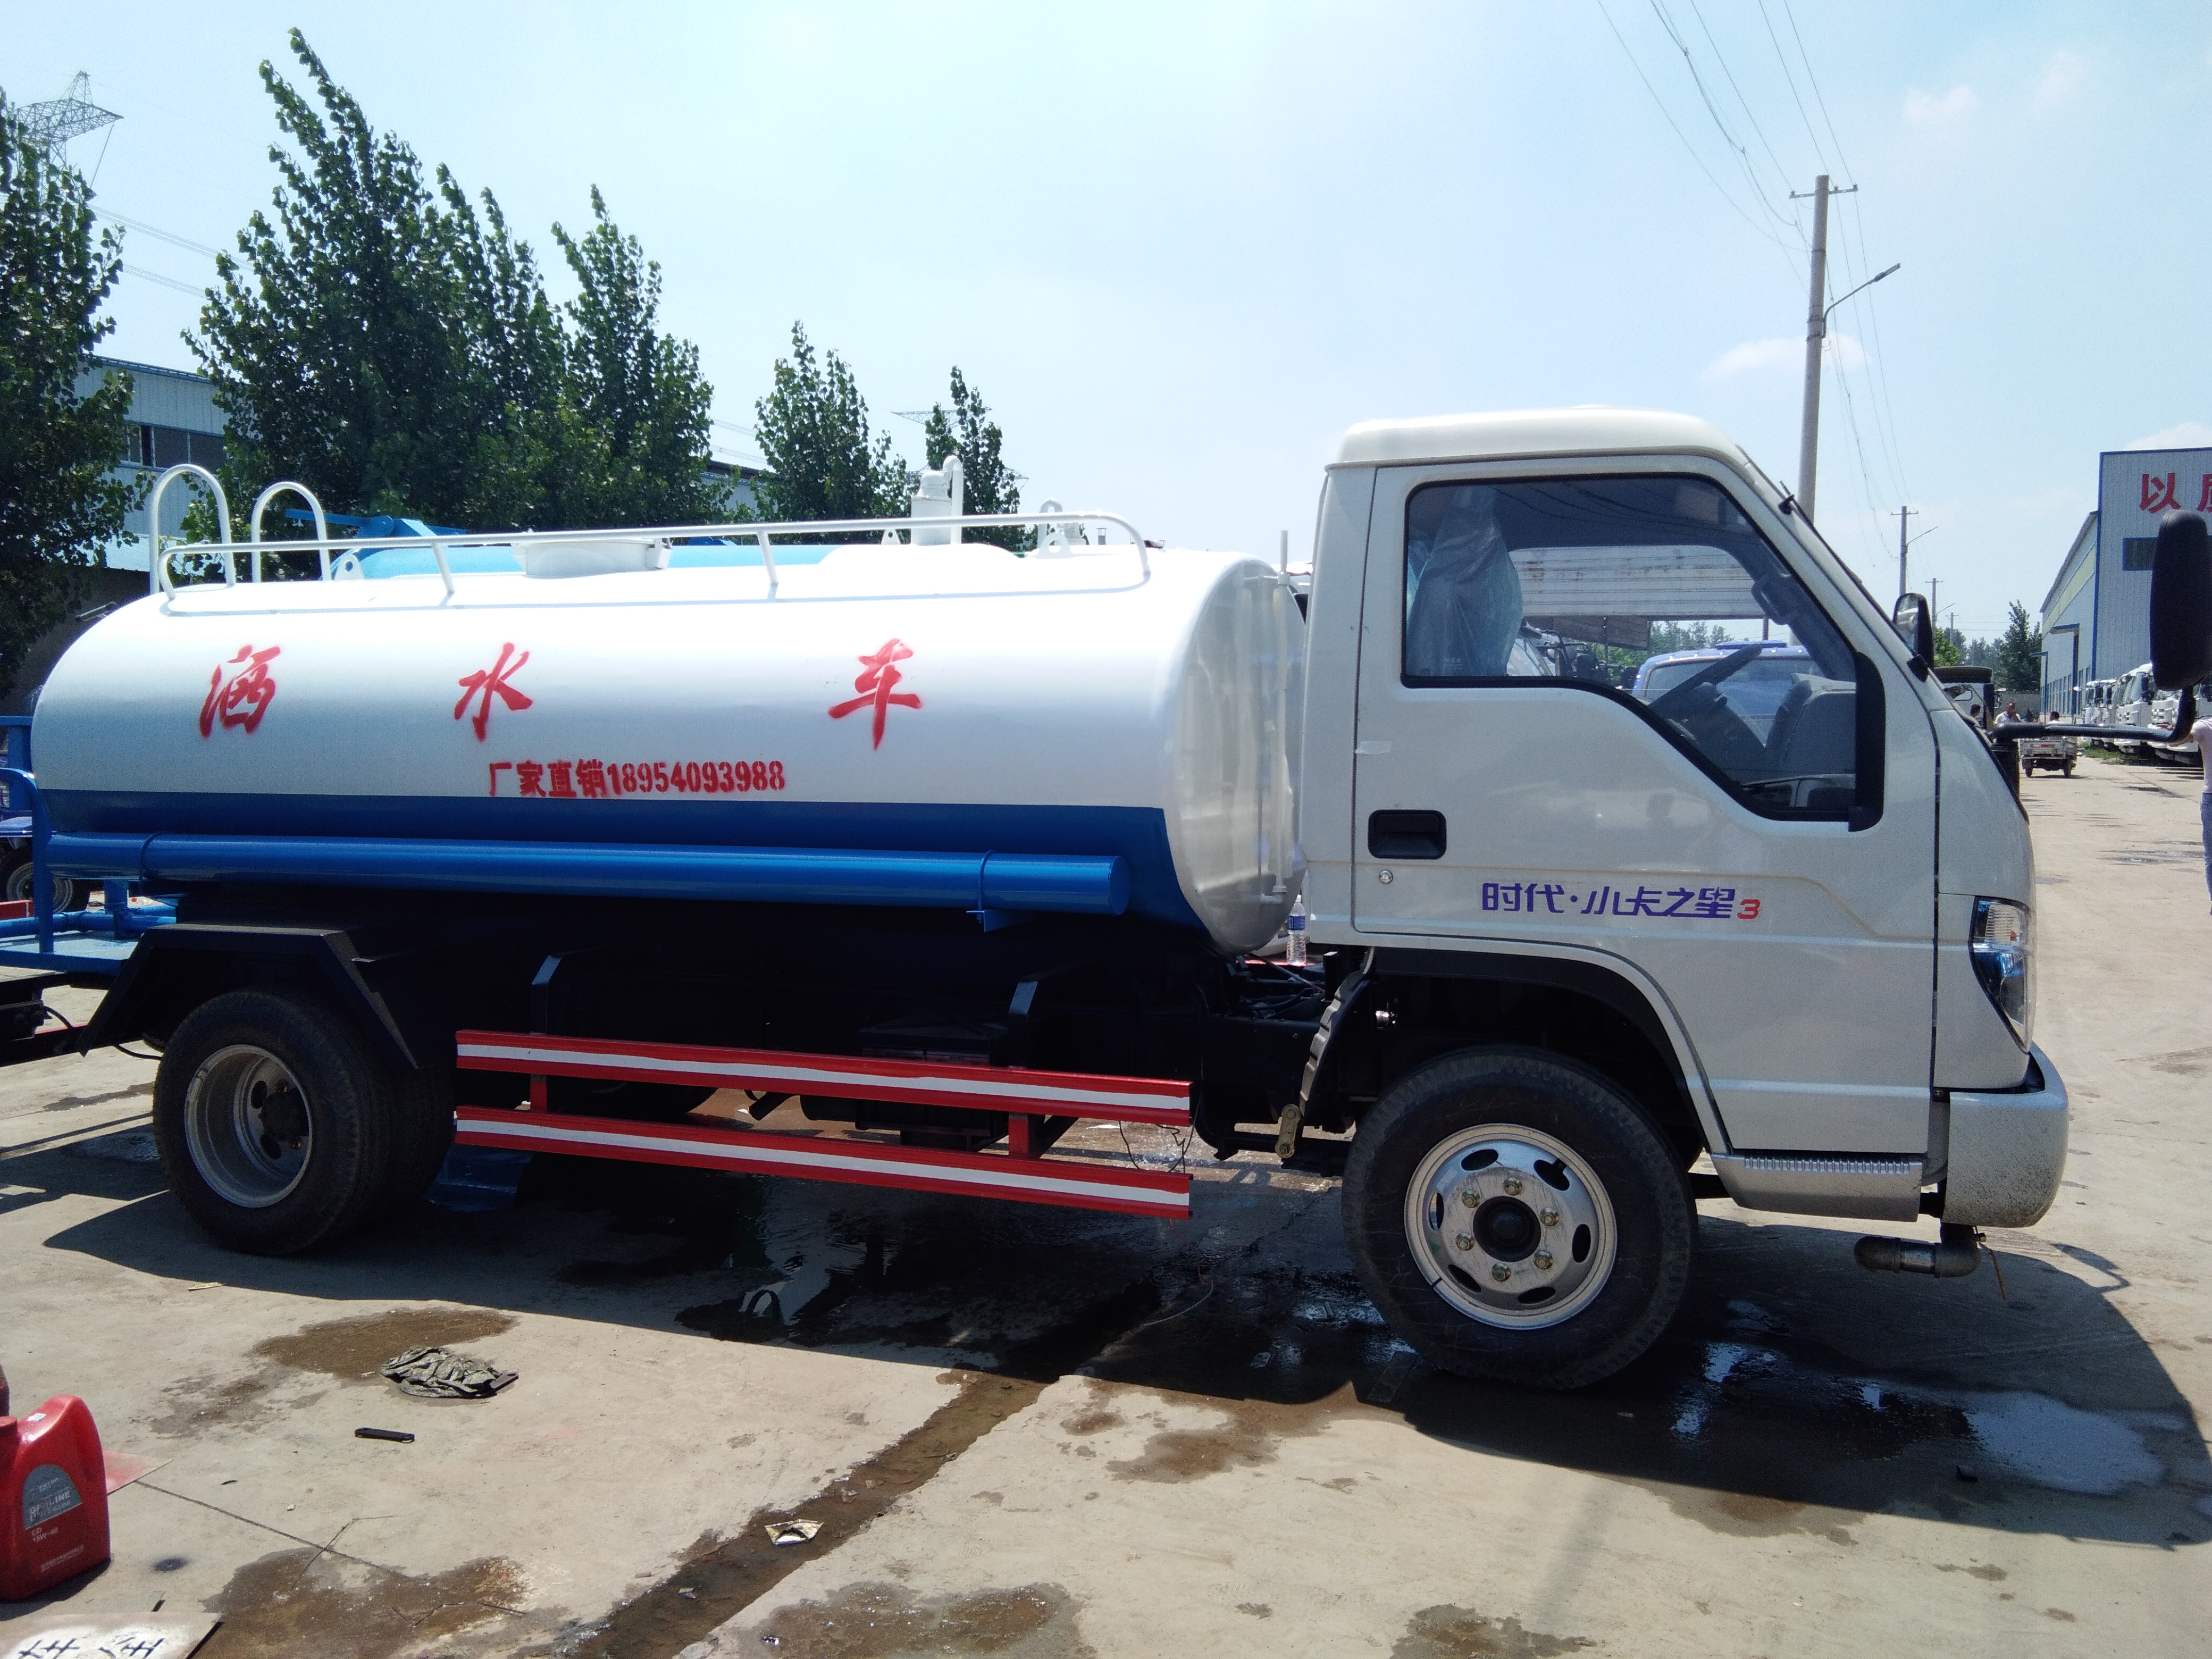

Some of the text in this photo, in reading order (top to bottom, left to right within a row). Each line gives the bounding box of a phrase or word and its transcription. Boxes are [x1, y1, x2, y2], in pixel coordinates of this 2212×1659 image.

[199, 638, 923, 751] 洒 水 车
[488, 759, 785, 798] 厂家直销18954093988
